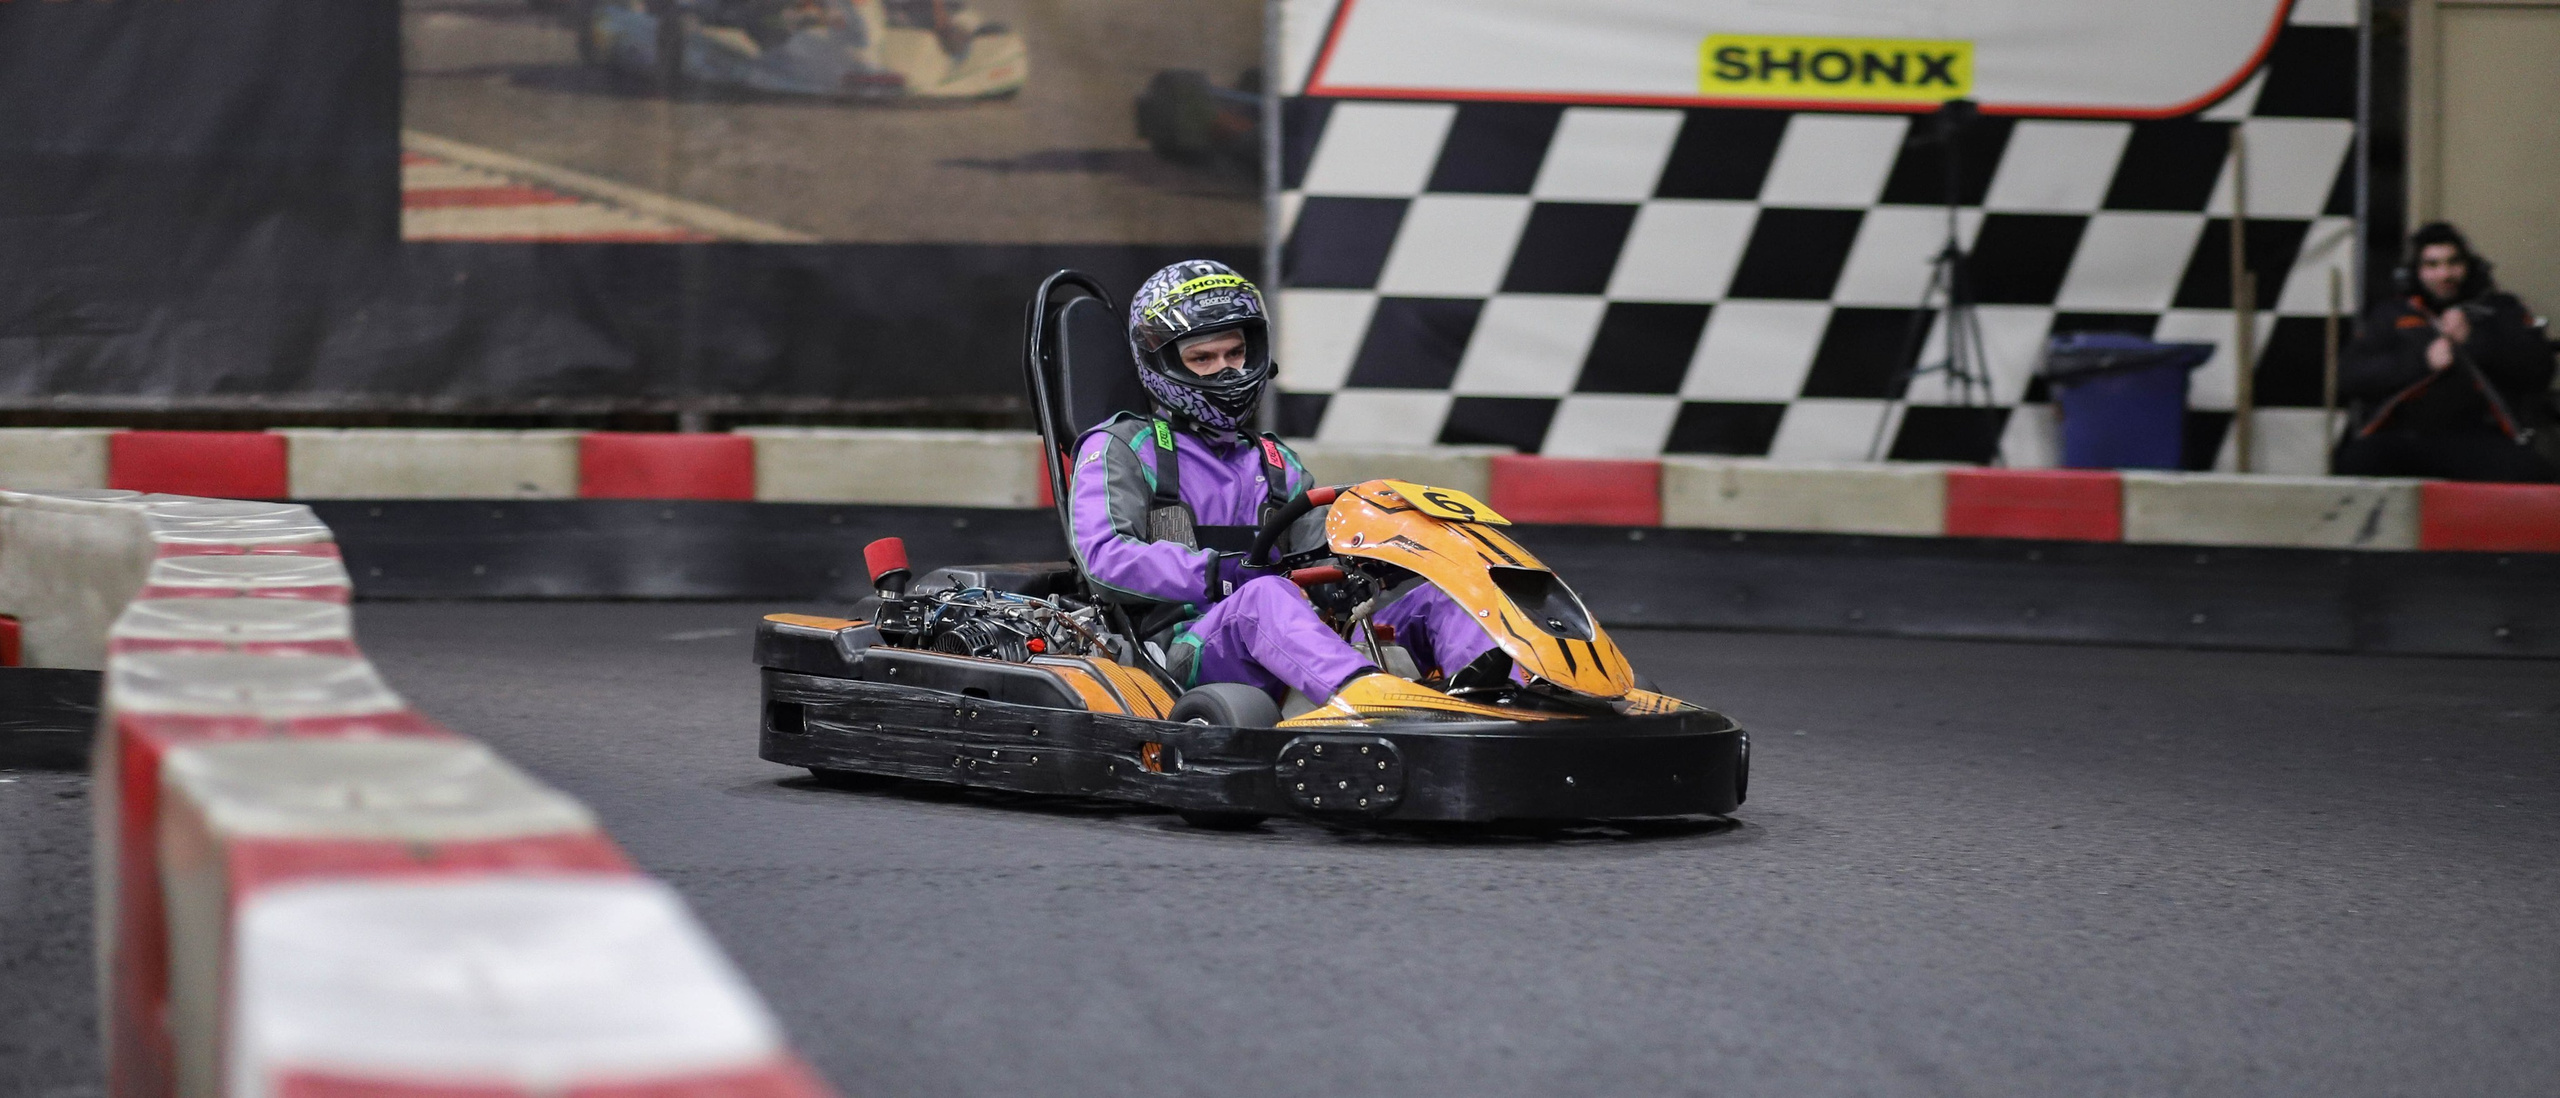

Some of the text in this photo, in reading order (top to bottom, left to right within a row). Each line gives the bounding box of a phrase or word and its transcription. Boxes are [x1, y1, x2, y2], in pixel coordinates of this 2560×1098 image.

[1711, 45, 1960, 87] SHONX
[1182, 278, 1237, 294] SHONX
[1422, 491, 1475, 516] 6
